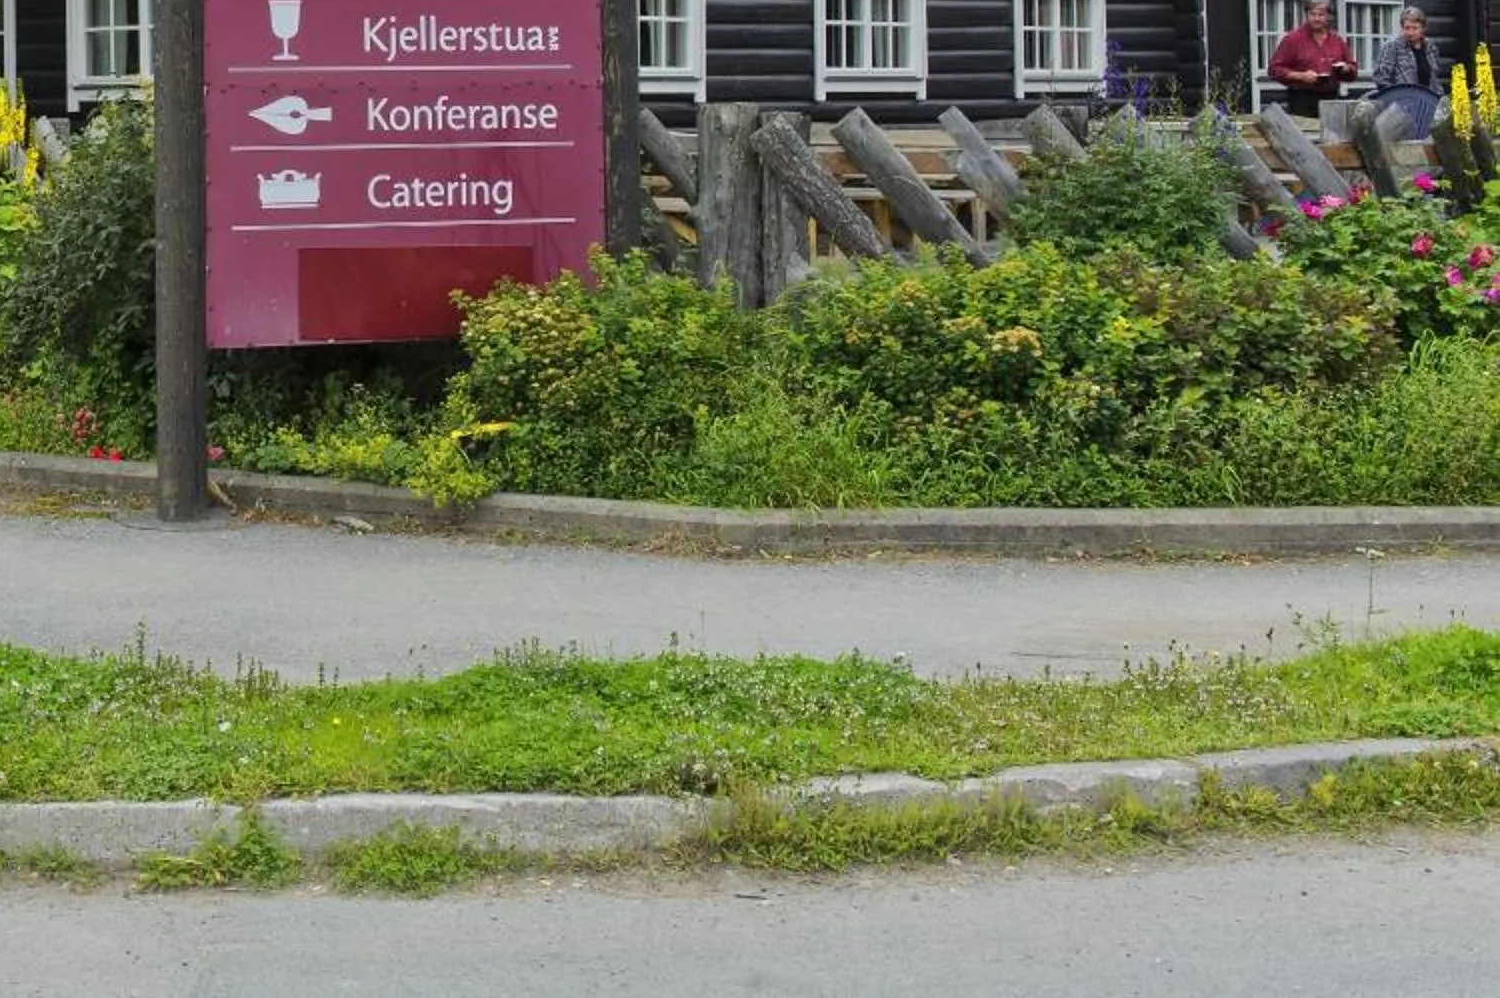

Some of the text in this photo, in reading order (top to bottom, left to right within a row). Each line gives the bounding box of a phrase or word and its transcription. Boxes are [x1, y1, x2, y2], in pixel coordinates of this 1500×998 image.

[363, 15, 546, 60] Kjellerstua
[367, 95, 558, 132] Konferanse
[367, 173, 514, 213] Catering
